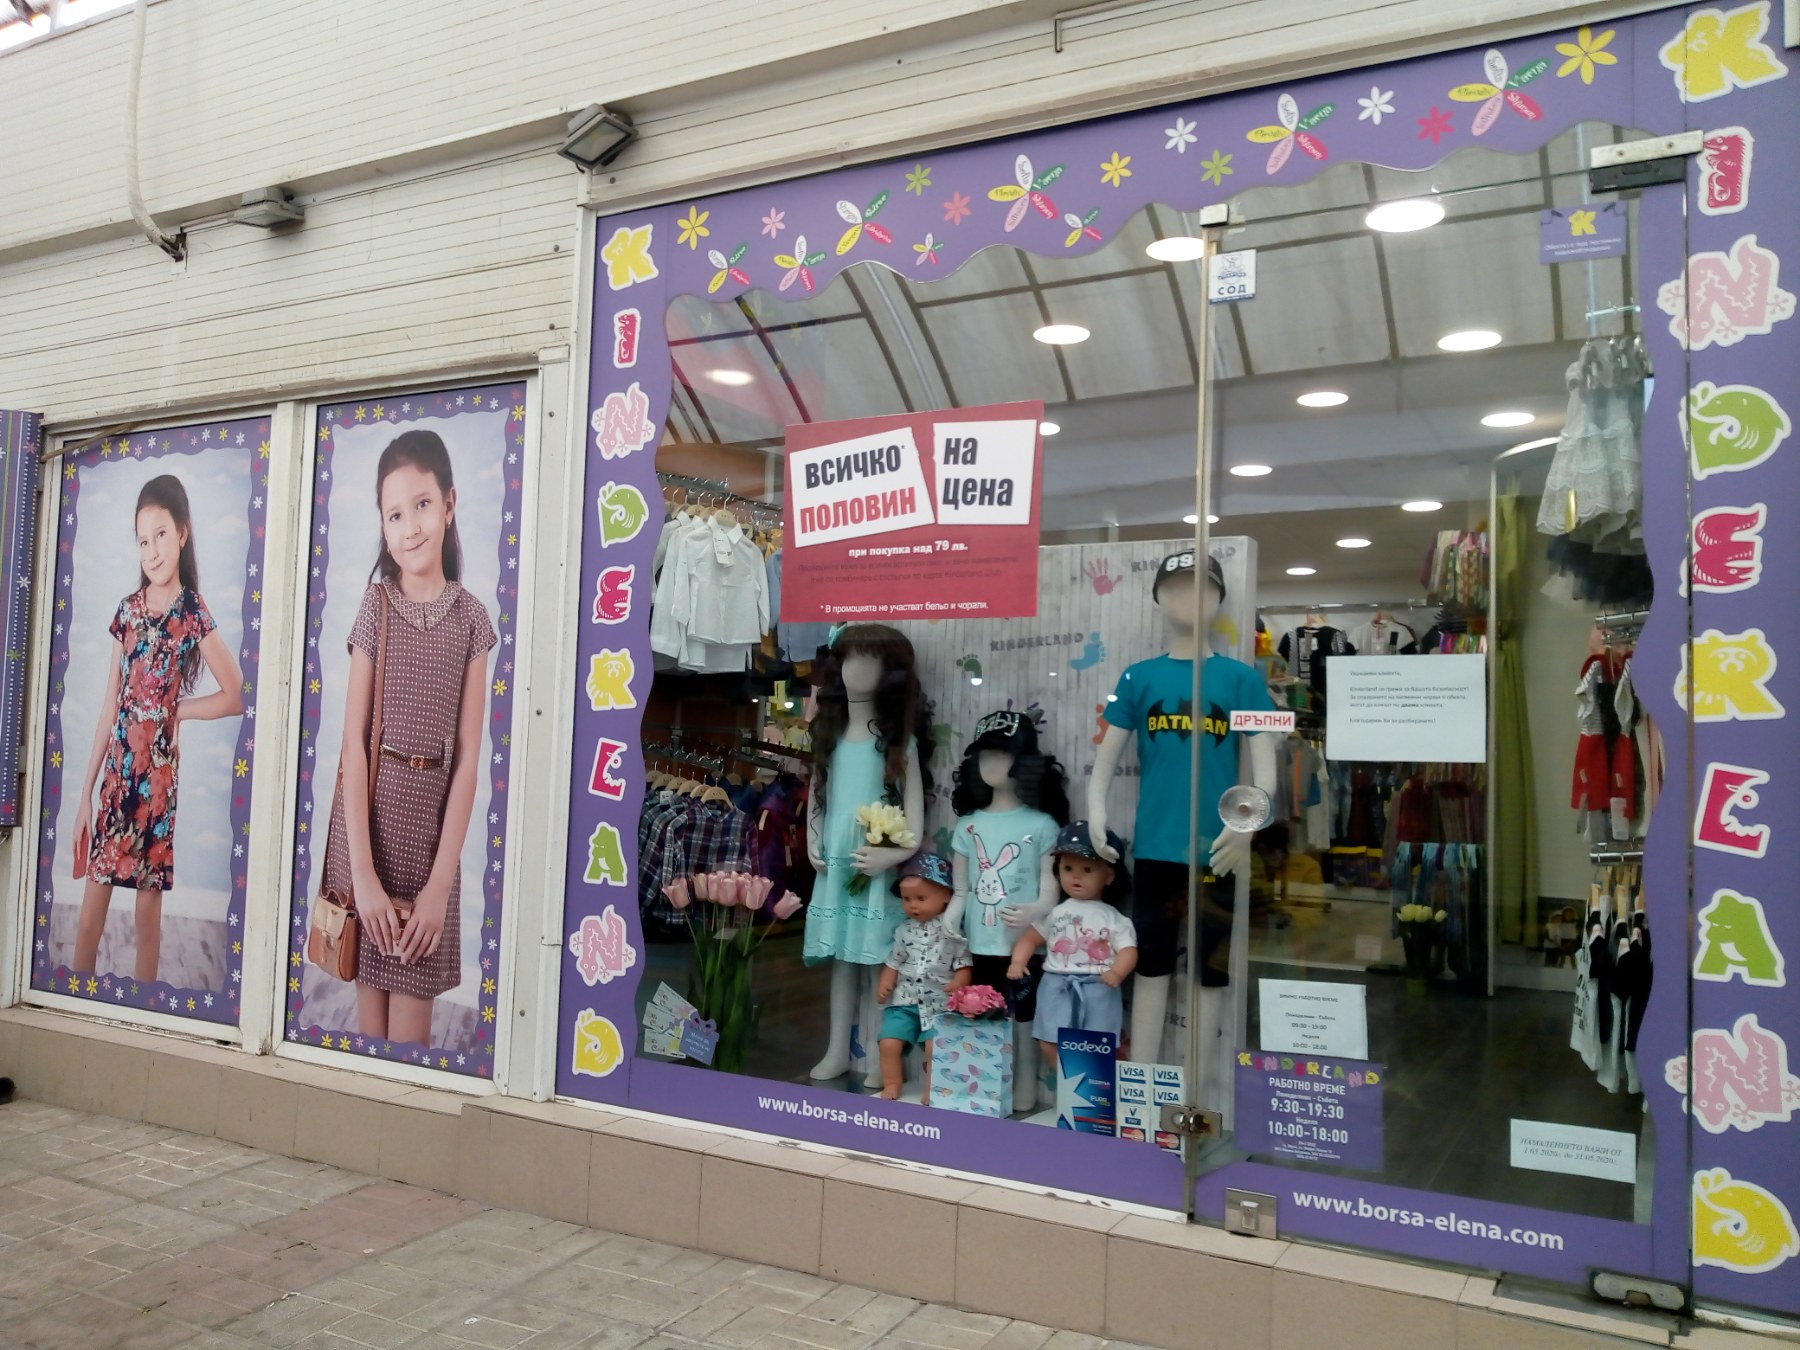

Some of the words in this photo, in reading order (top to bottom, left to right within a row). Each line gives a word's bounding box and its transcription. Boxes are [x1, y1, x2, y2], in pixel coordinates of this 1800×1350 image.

[943, 437, 978, 465] на
[942, 477, 1014, 510] цена
[849, 548, 867, 558] при
[869, 546, 911, 557] покупка
[913, 545, 933, 554] над
[935, 540, 949, 551] 79
[951, 543, 968, 551] лв.
[833, 605, 877, 614] промоцията
[890, 603, 923, 613] участват
[925, 602, 948, 610] бельо
[1234, 715, 1291, 727] ДРЪПНИ
[1061, 1039, 1111, 1054] sodexo
[1123, 1067, 1144, 1077] VISA
[1157, 1070, 1179, 1081] VISA
[1123, 1087, 1144, 1098] VISA
[1269, 1077, 1310, 1090] РАБОТНО
[1313, 1083, 1346, 1095] ВРЕМЕ
[1157, 1091, 1179, 1101] VISA
[758, 1095, 941, 1140] www.borsa-elena.com
[1271, 1098, 1344, 1119] 9:30-19:30
[1268, 1121, 1348, 1144] 10:00-18:00
[1292, 1191, 1564, 1251] www.borsa-elena.com
